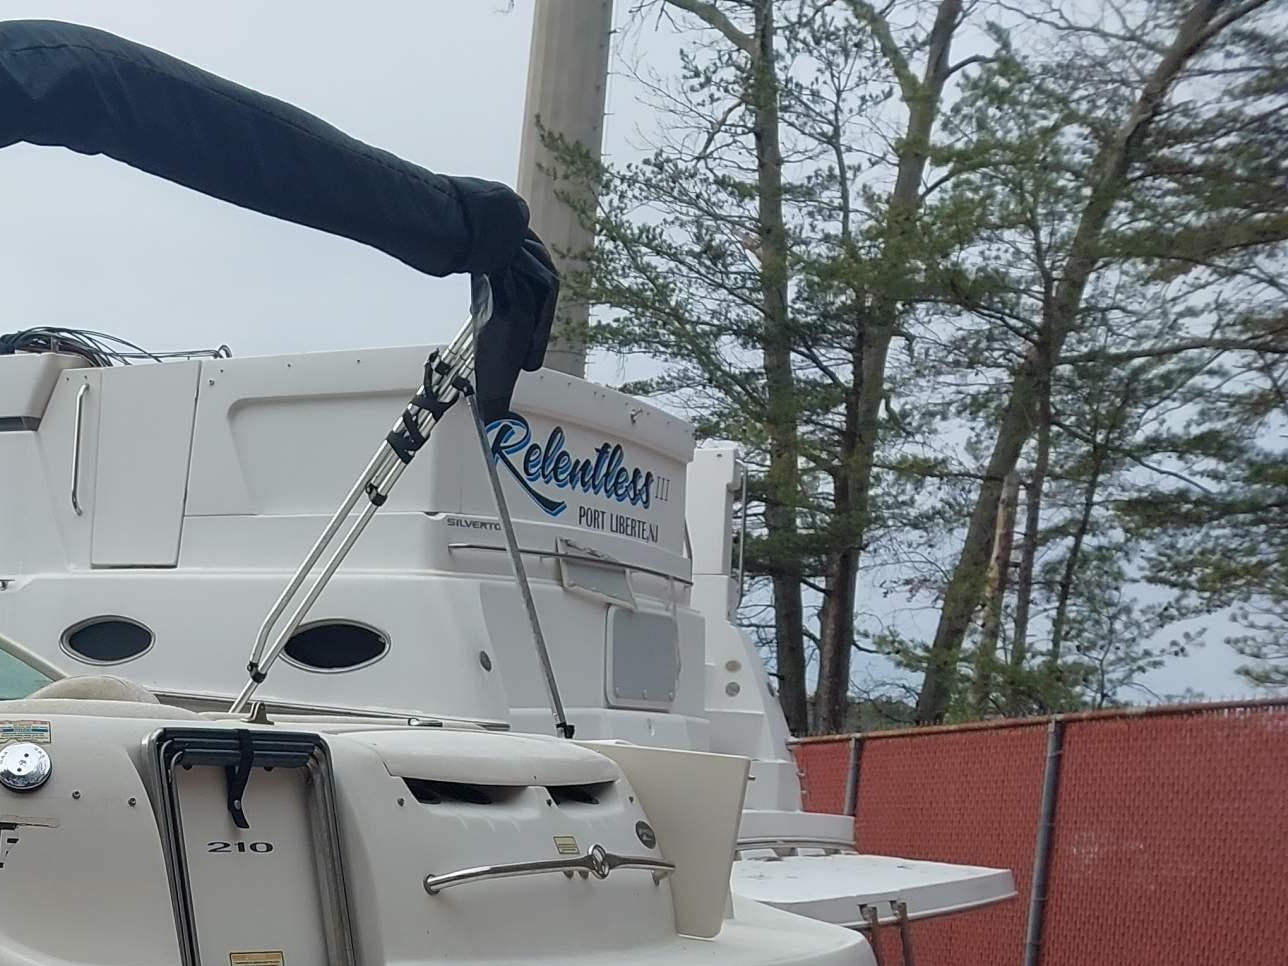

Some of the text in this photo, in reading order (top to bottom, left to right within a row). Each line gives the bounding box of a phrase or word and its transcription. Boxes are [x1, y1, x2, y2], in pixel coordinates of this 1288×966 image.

[485, 410, 671, 517] Relentless III
[447, 517, 502, 531] SILVERTO
[579, 505, 607, 530] PORT
[207, 841, 274, 853] 210
